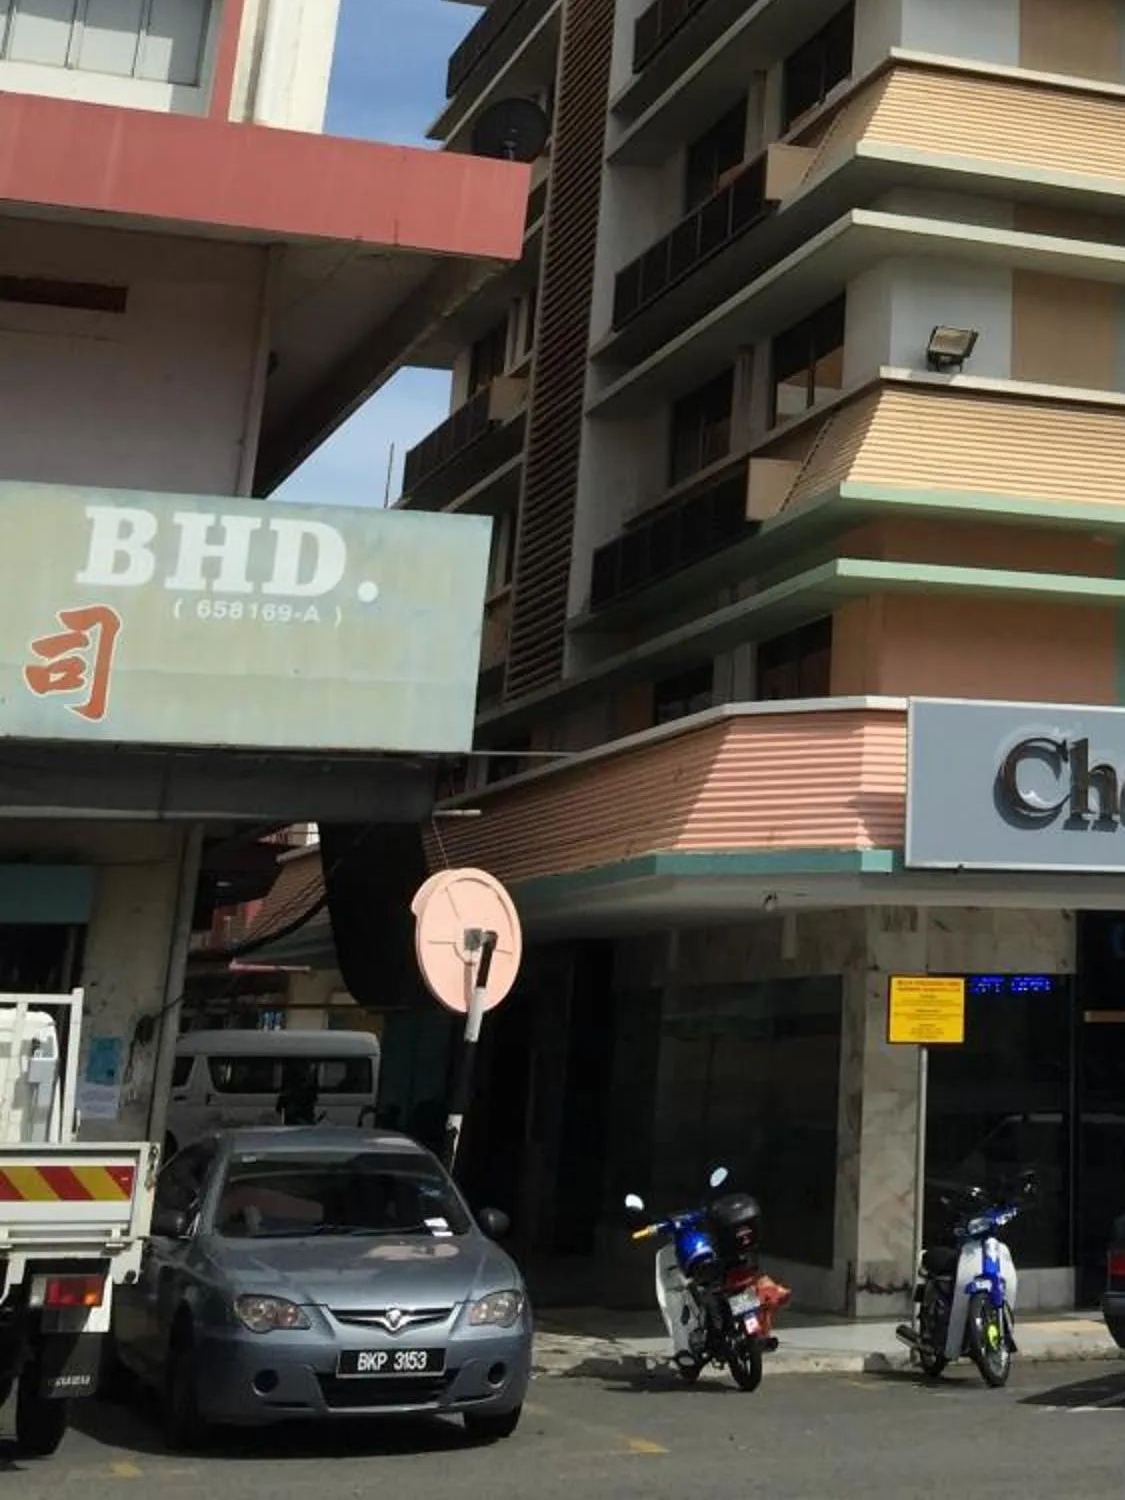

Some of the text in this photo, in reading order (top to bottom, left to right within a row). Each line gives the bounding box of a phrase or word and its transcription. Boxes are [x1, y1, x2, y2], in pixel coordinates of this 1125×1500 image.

[76, 505, 379, 602] BHD.
[25, 603, 123, 722] 司
[357, 1351, 427, 1371] BKP 3153
